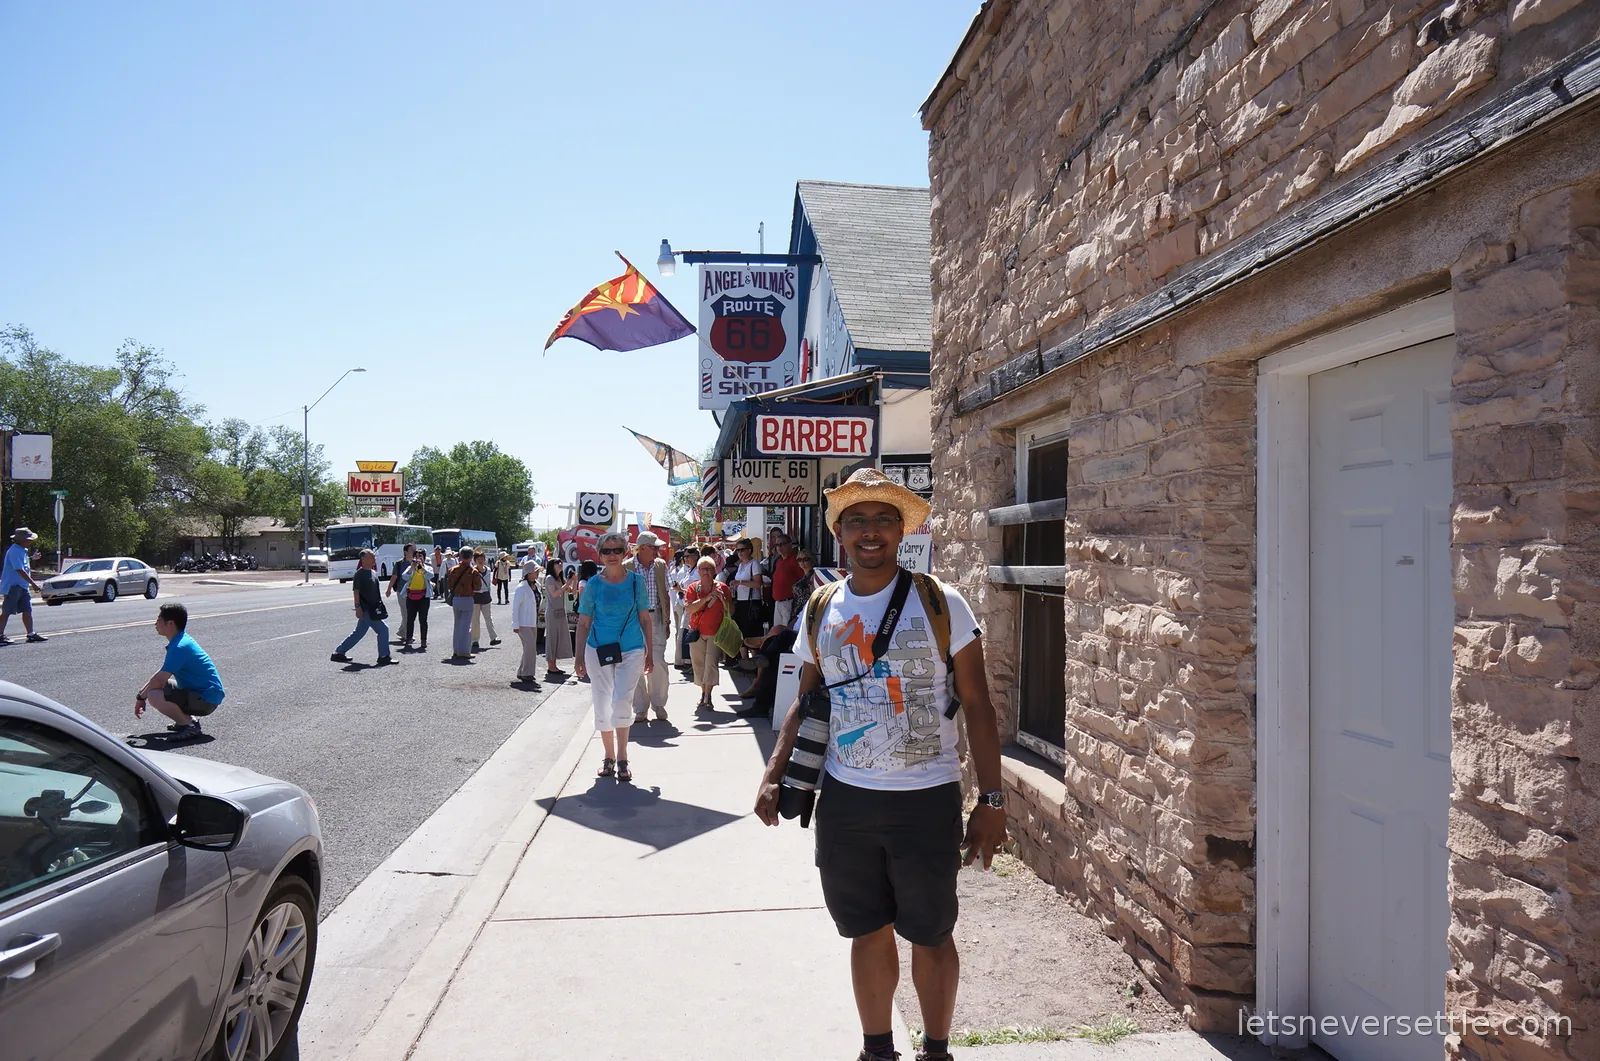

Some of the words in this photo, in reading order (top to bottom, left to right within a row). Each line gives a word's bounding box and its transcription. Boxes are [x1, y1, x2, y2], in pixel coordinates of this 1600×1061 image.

[703, 270, 744, 302] ANGEL
[744, 275, 751, 285] &
[750, 268, 795, 300] VILMA'S
[722, 300, 774, 317] ROUTE
[726, 320, 771, 350] 66
[723, 366, 771, 380] GIFT
[718, 381, 778, 395] SHOP
[762, 418, 868, 453] BARBER
[732, 460, 781, 479] ROUTE
[788, 461, 809, 479] 66
[350, 475, 401, 493] MOTEL
[913, 477, 924, 485] 66
[732, 484, 809, 504] Memorabilia
[583, 499, 610, 518] 66
[904, 542, 925, 556] Carry
[897, 555, 916, 569] ducts
[881, 608, 898, 635] Canon
